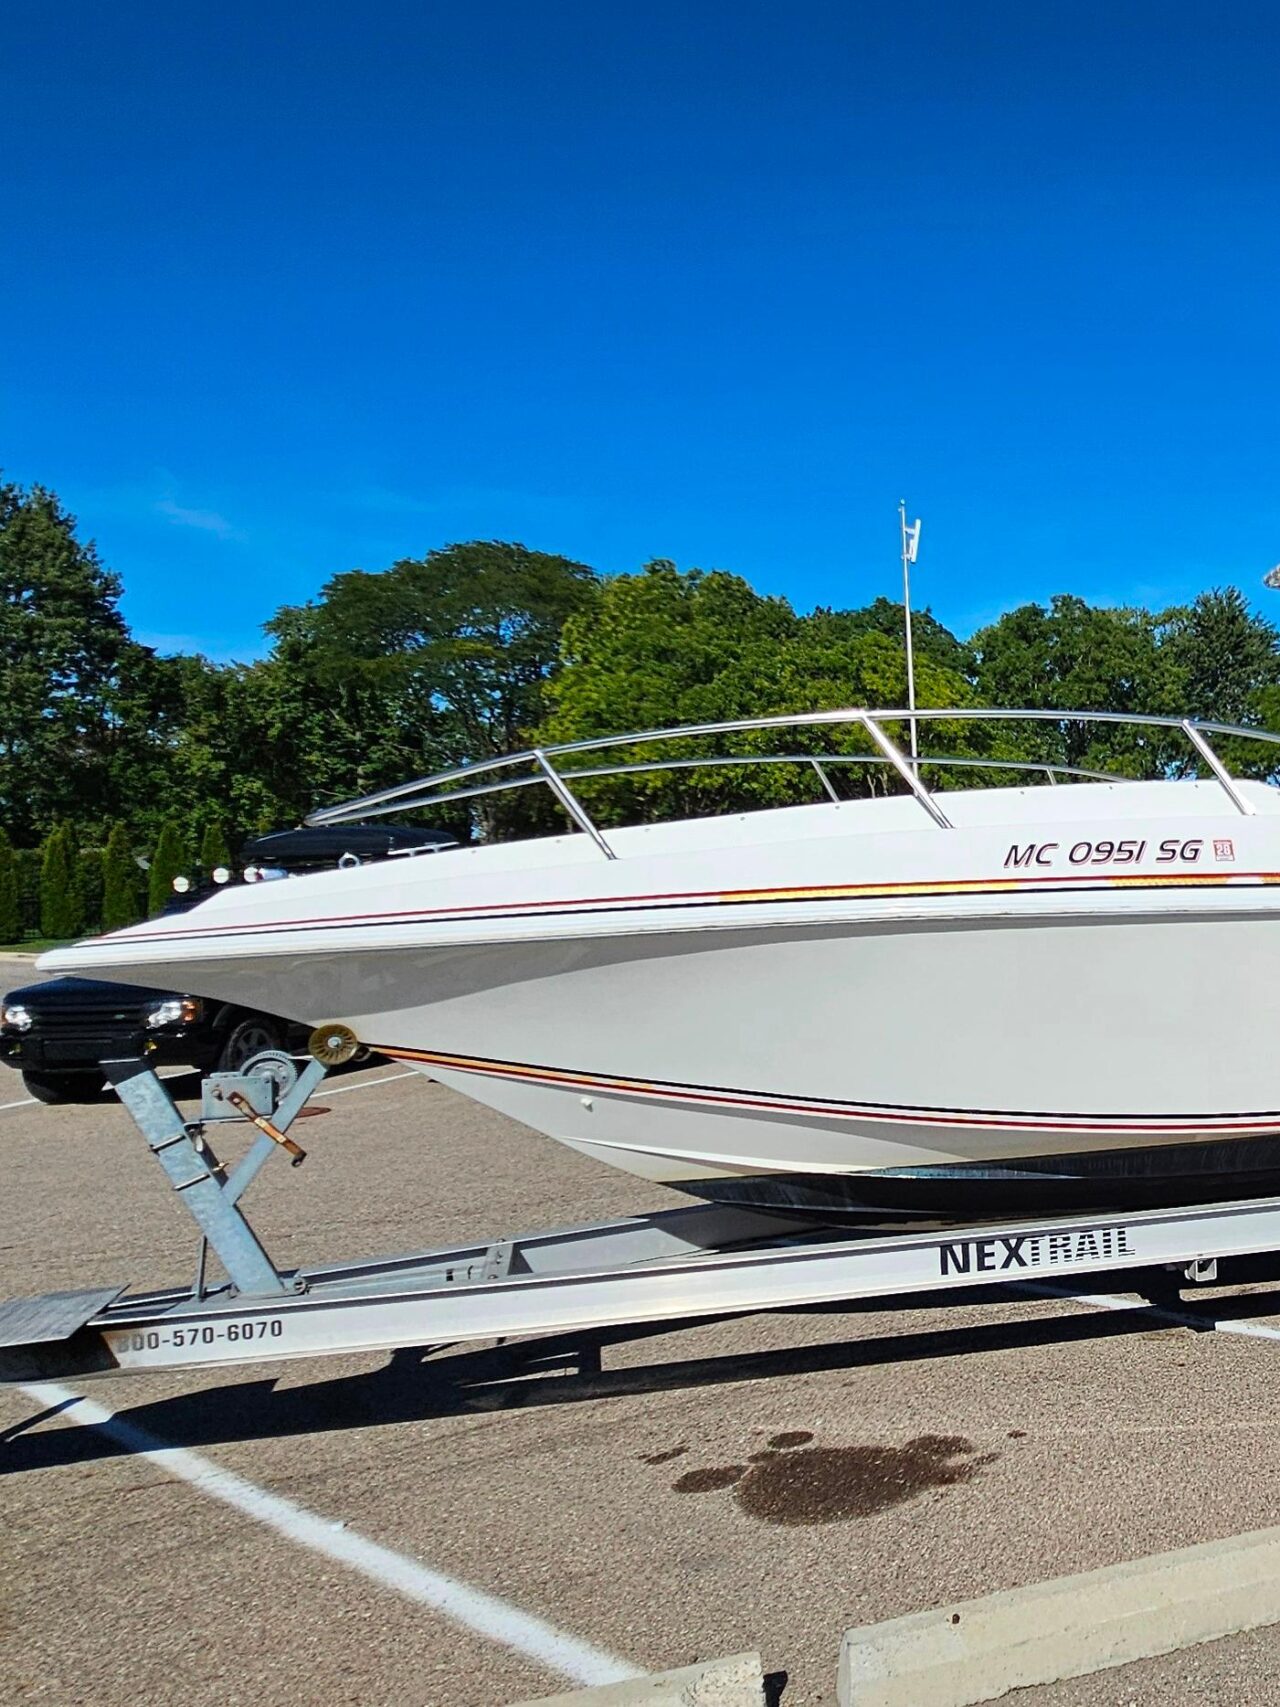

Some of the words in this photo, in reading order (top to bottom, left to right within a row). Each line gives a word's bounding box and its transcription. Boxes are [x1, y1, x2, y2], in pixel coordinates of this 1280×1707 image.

[1003, 842, 1058, 868] MC
[1068, 840, 1146, 866] 0951
[1155, 839, 1204, 863] SG
[939, 1225, 1136, 1276] NEXTRAIL
